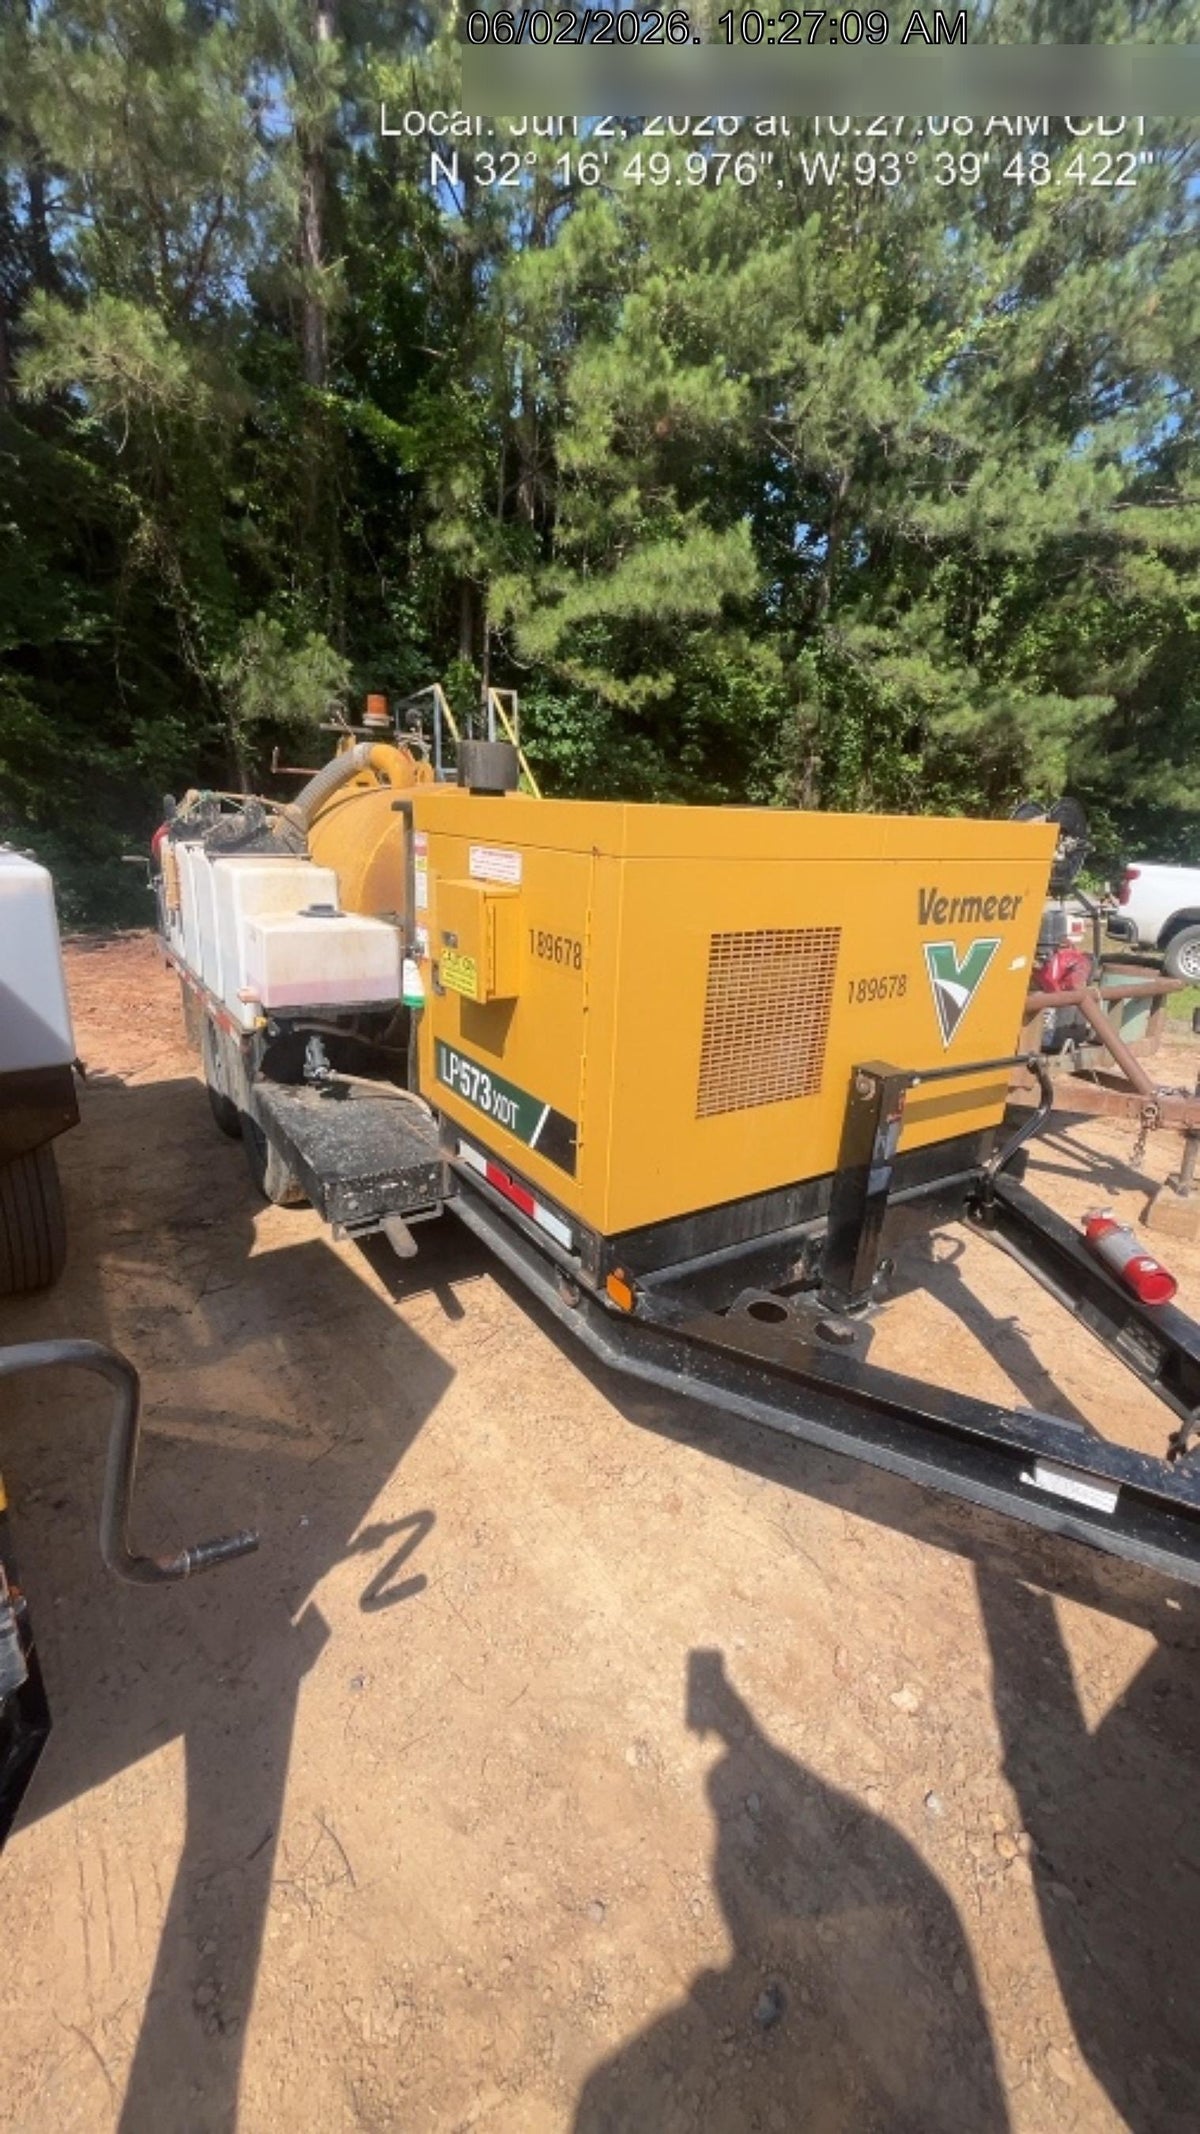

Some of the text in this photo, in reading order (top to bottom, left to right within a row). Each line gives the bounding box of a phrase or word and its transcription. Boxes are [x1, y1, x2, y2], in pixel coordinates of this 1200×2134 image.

[917, 886, 1023, 926] Vermeer
[528, 929, 582, 971] 189678
[848, 974, 908, 1004] 189678
